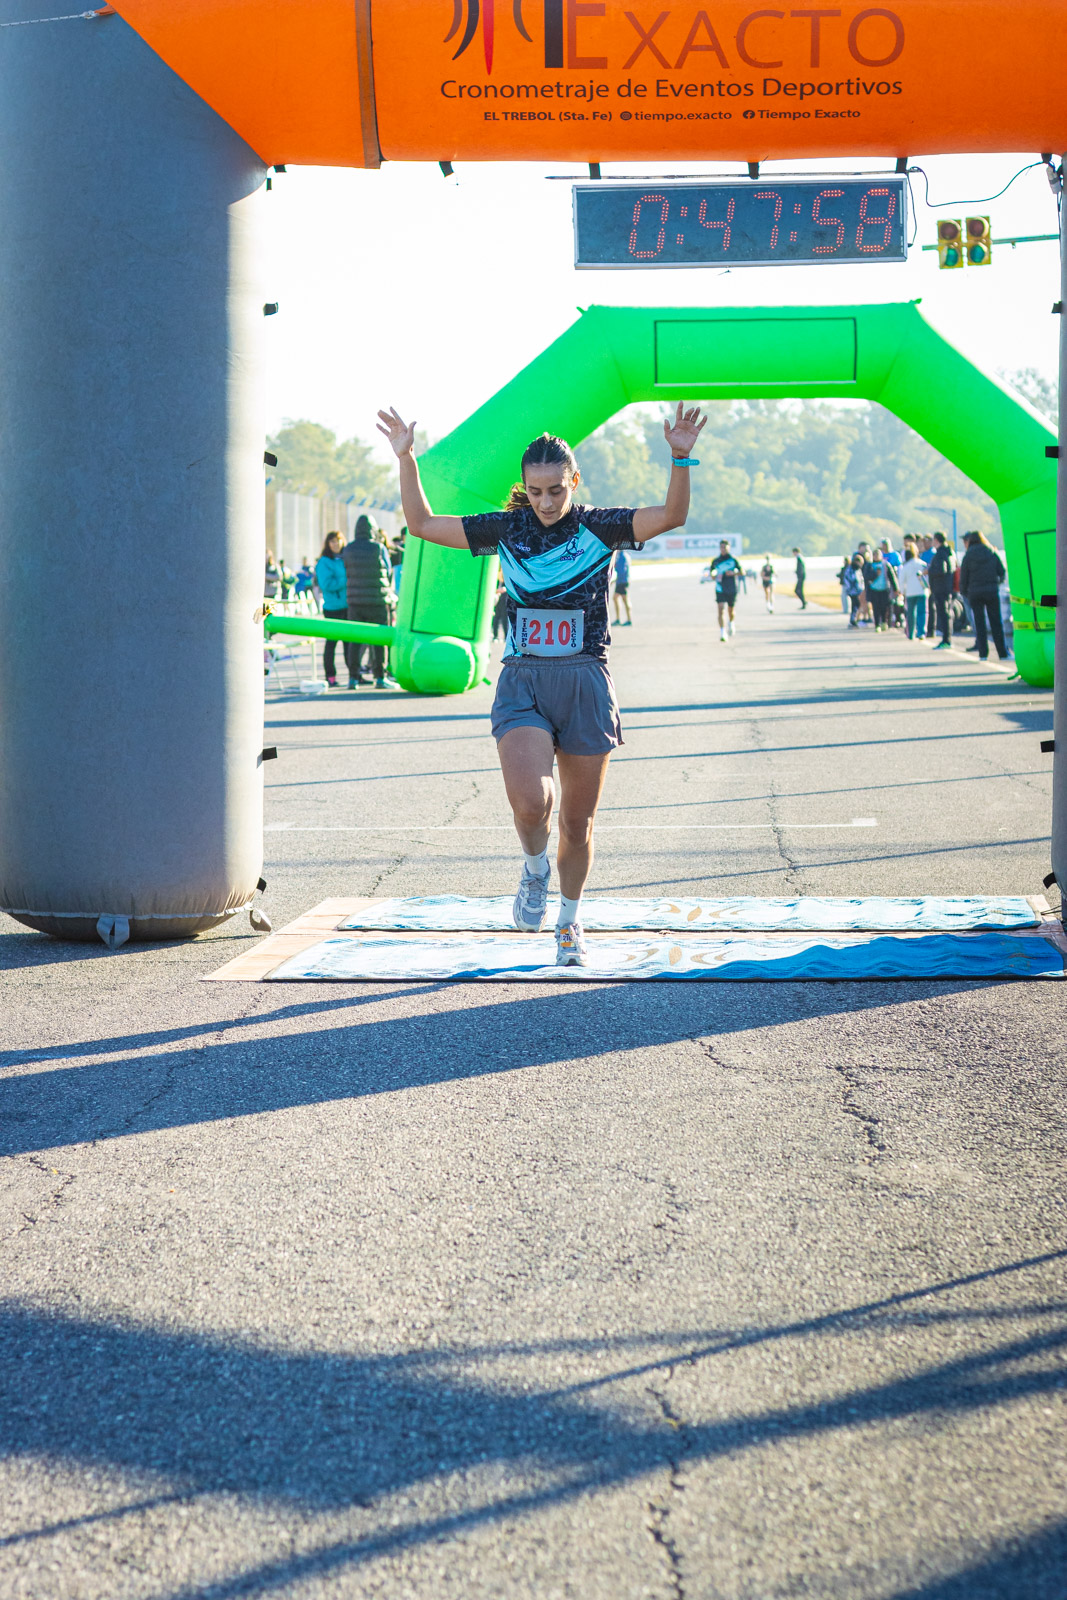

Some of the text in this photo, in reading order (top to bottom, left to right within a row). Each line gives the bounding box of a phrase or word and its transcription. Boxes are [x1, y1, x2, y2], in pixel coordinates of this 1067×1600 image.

[440, 77, 903, 103] Cronometraje de Eventos Deportivos
[483, 109, 861, 122] EL TREBOL (Sta. Fe) tiempo.exacto Tiempo Exacto
[628, 188, 897, 259] 0:47:58
[528, 619, 572, 646] 210
